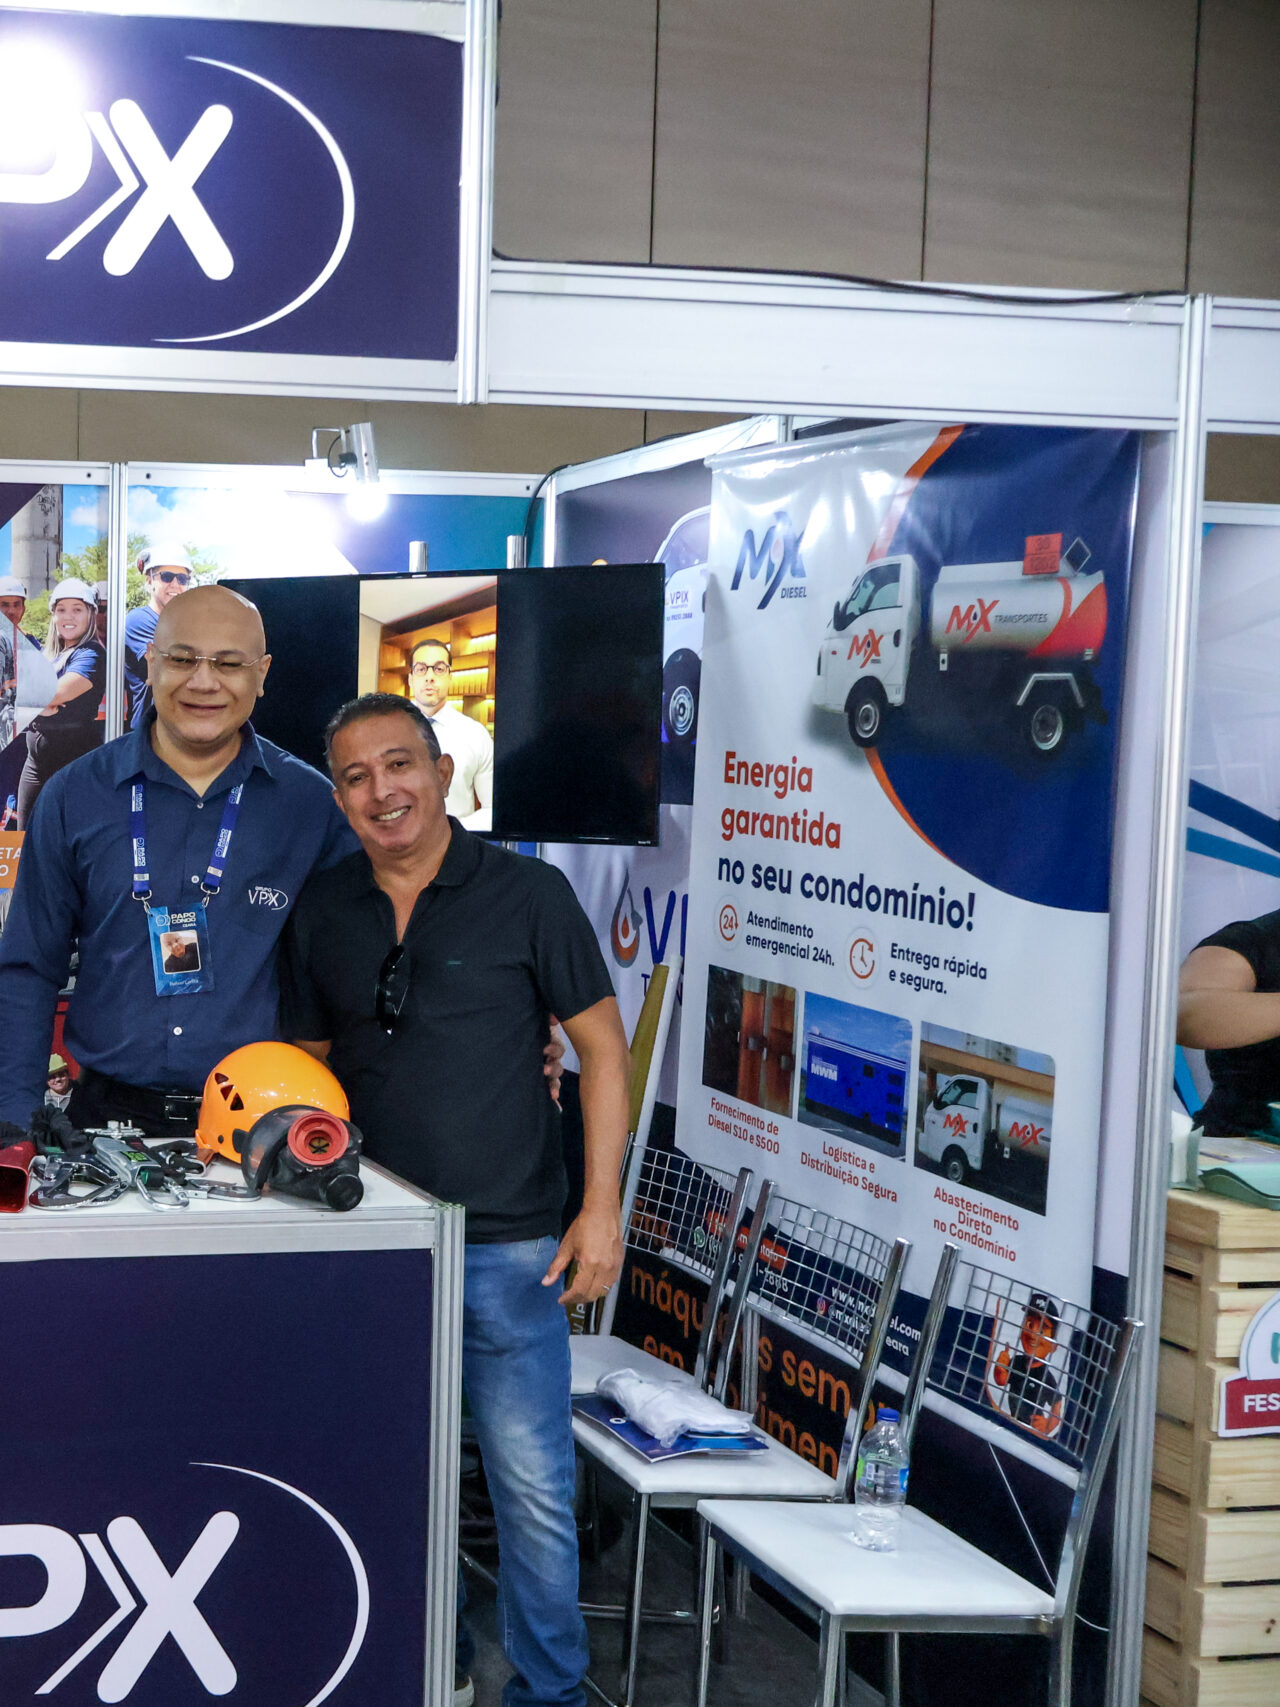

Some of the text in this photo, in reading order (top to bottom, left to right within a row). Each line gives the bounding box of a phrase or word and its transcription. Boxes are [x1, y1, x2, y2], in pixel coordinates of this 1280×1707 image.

[780, 586, 807, 599] DIESEL
[995, 613, 1049, 624] TRANSPORTES
[723, 751, 813, 799] Energia
[721, 806, 841, 849] garantida
[248, 889, 279, 907] VPX
[718, 857, 976, 932] no seu condomínio!
[171, 912, 196, 920] PAPO
[723, 915, 734, 931] 24
[747, 911, 814, 939] Atendimento
[746, 934, 835, 967] emergencial 24h.
[890, 943, 988, 980] Entrega rápida
[888, 968, 948, 995] e segura.
[811, 1063, 838, 1082] MWM
[711, 1097, 779, 1136] Fornecimento de
[708, 1113, 780, 1155] Diesel S10 e S500
[800, 1151, 898, 1203] Distribuição Segura
[869, 1163, 876, 1174] e
[933, 1186, 1019, 1231] Abastecimento
[958, 1210, 992, 1236] Direto
[933, 1218, 1017, 1262] no Condomínio
[781, 1350, 851, 1419] sem
